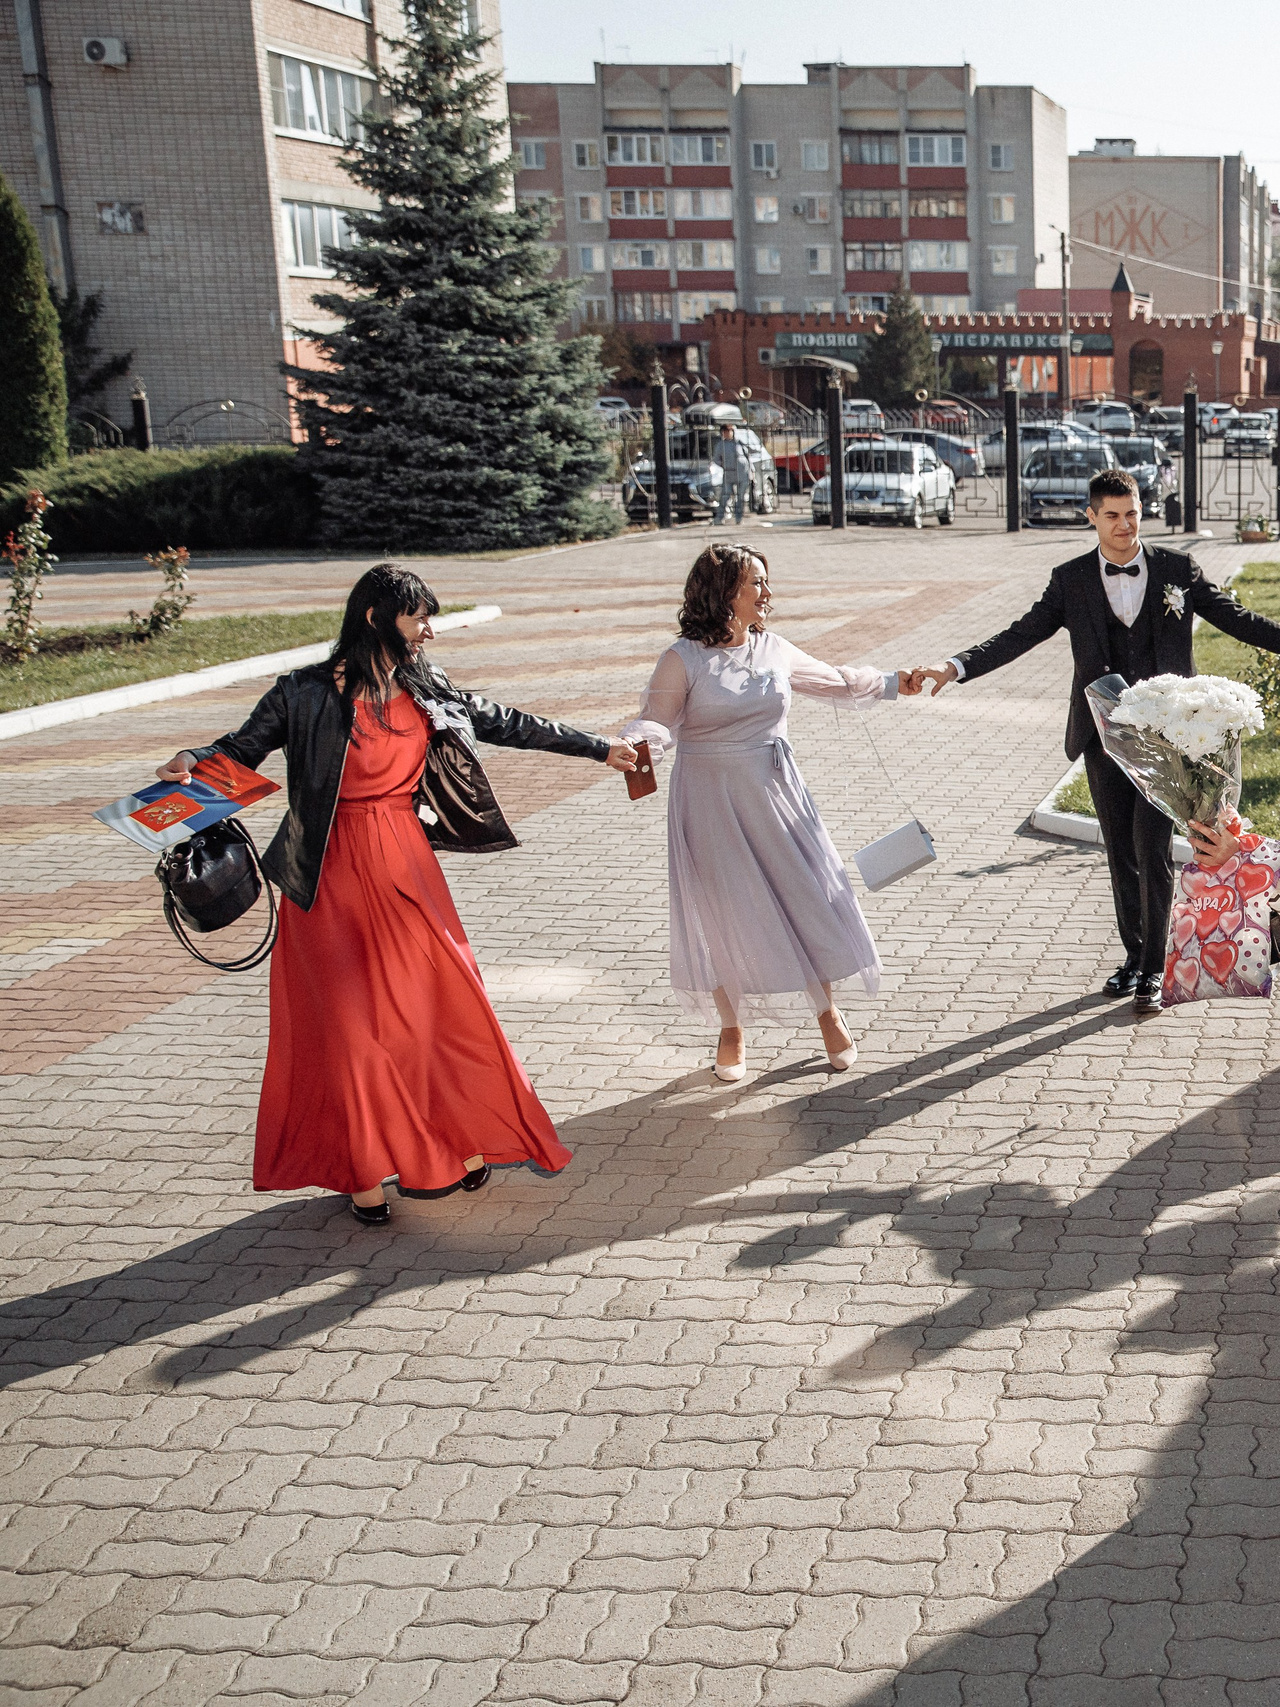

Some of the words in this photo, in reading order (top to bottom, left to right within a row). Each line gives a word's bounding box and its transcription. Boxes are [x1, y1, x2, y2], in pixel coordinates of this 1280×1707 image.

[1094, 204, 1171, 257] МЖК
[931, 334, 1070, 348] УПЕРМАРКЕ
[1192, 897, 1229, 912] УРА!
